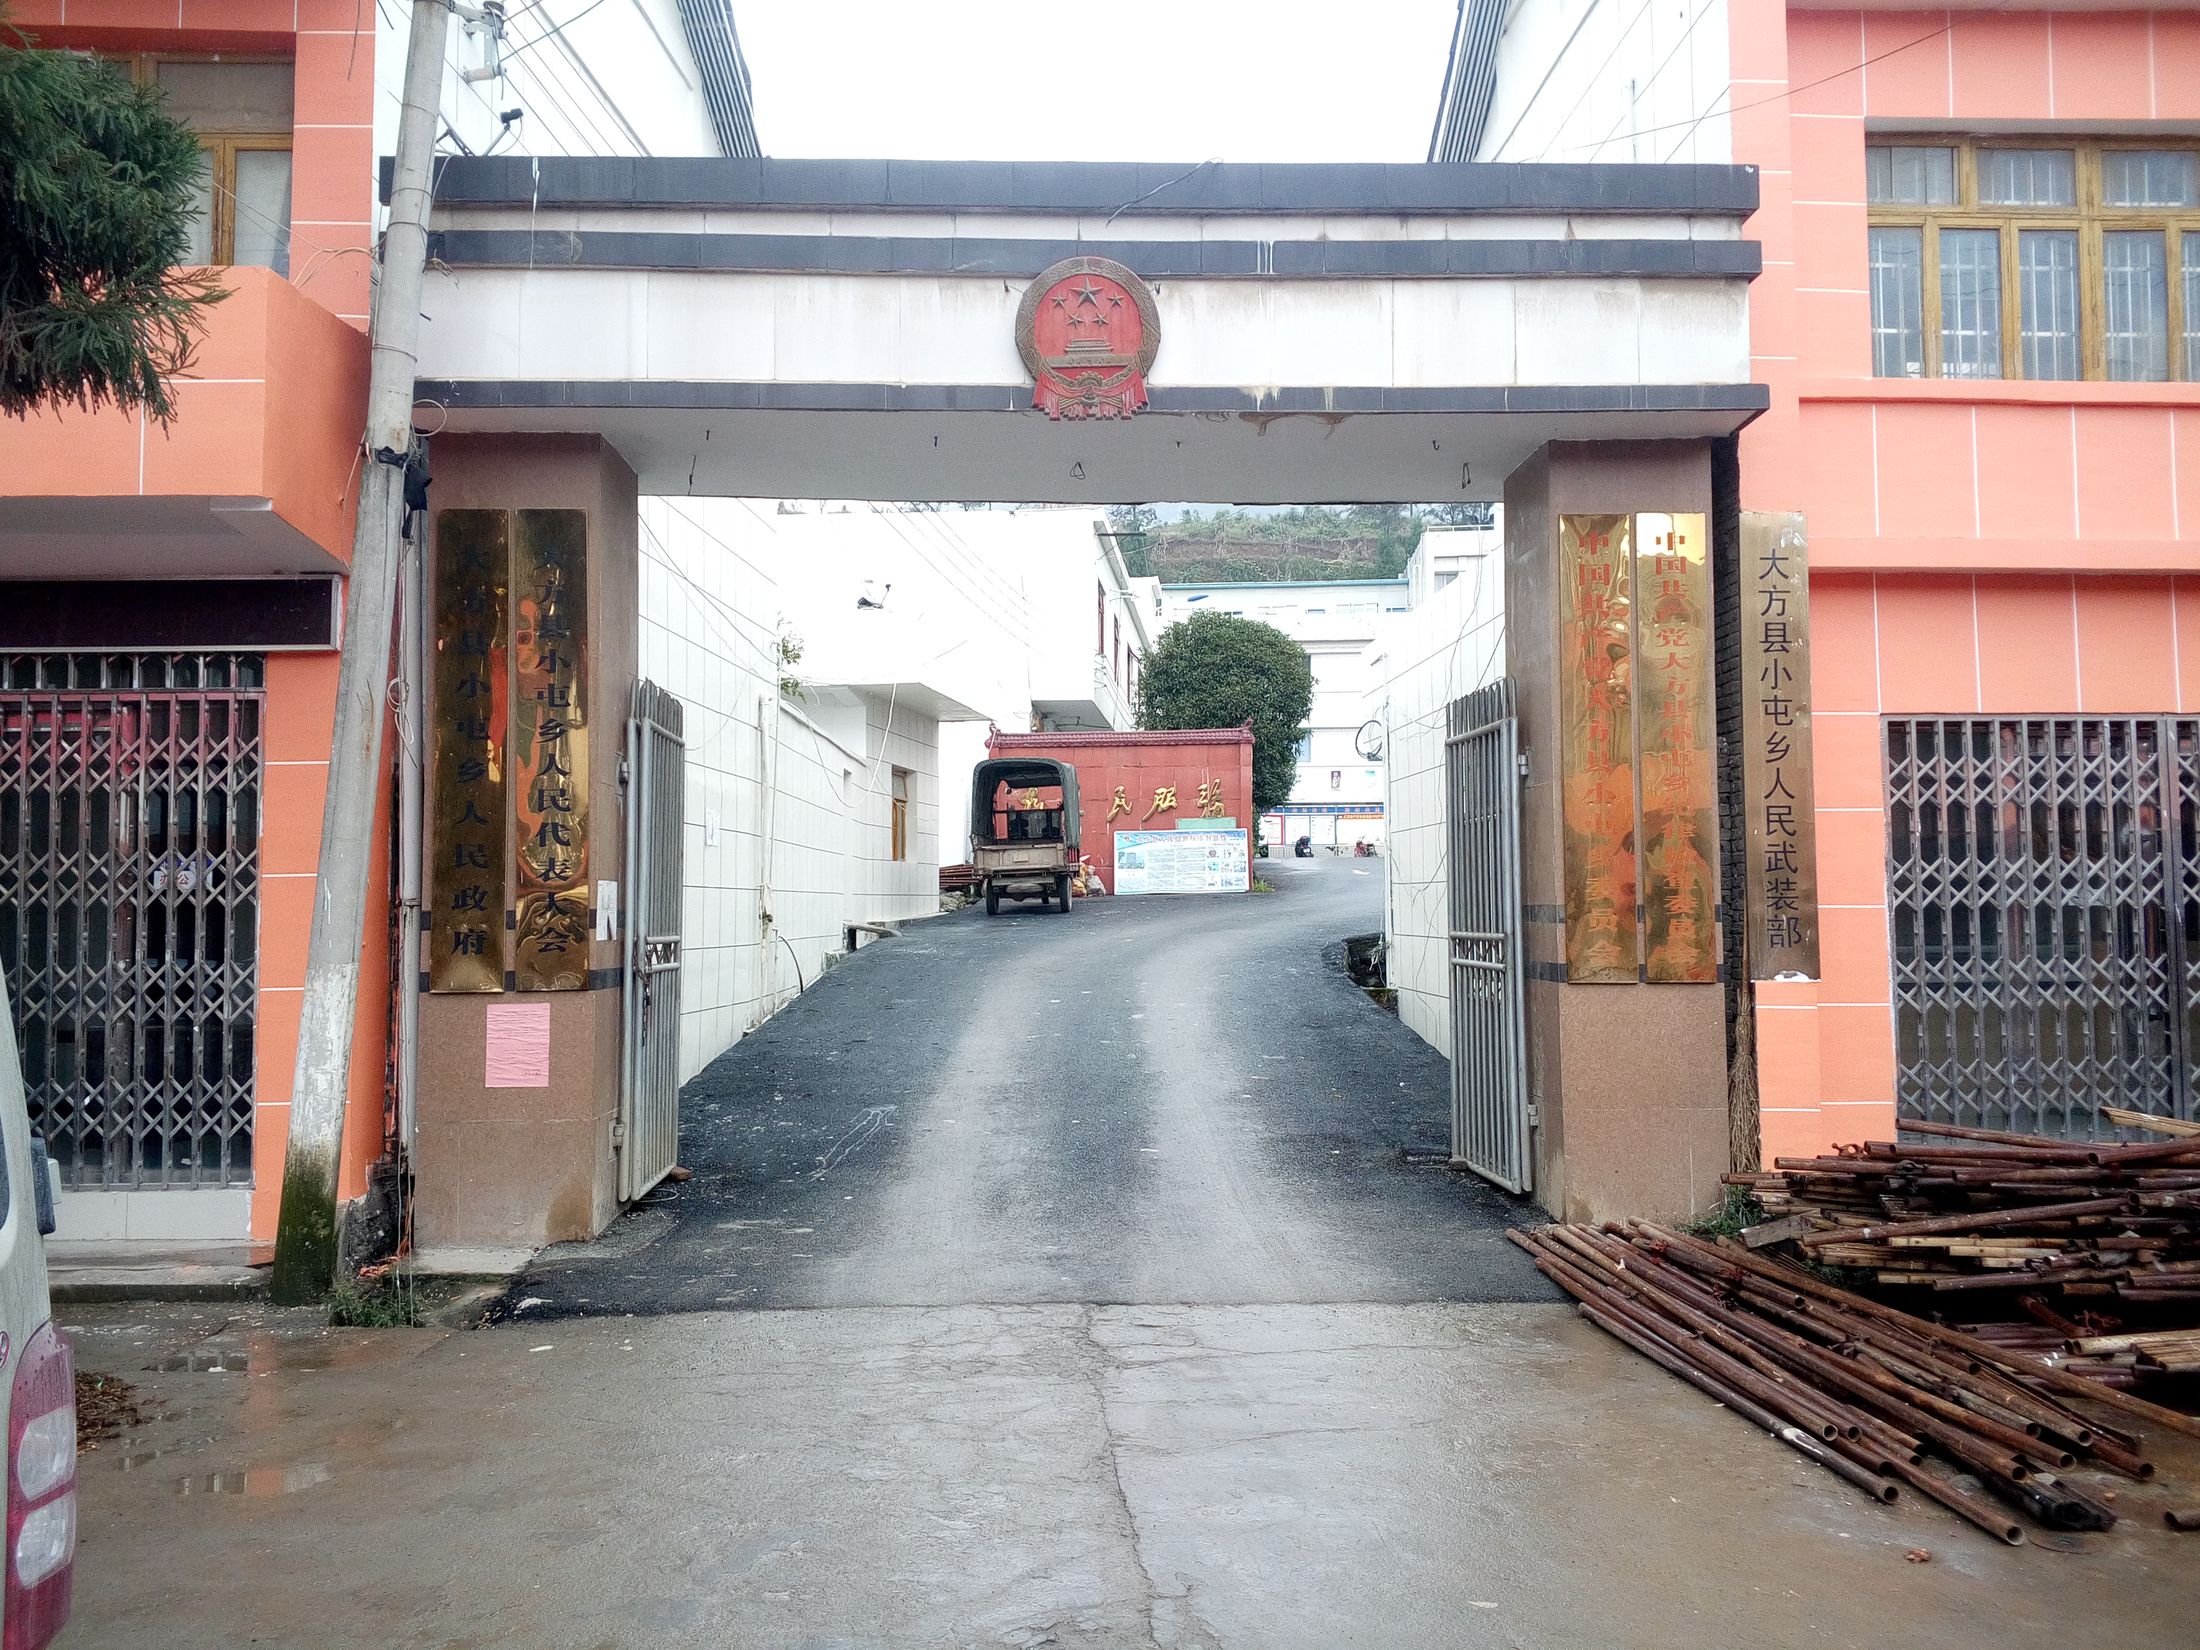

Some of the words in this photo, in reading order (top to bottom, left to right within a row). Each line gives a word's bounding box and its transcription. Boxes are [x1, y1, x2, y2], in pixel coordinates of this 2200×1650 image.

[534, 550, 572, 954] 大方县小屯乡人民代表大会
[1758, 548, 1802, 948] 大方县小屯乡人民武装部
